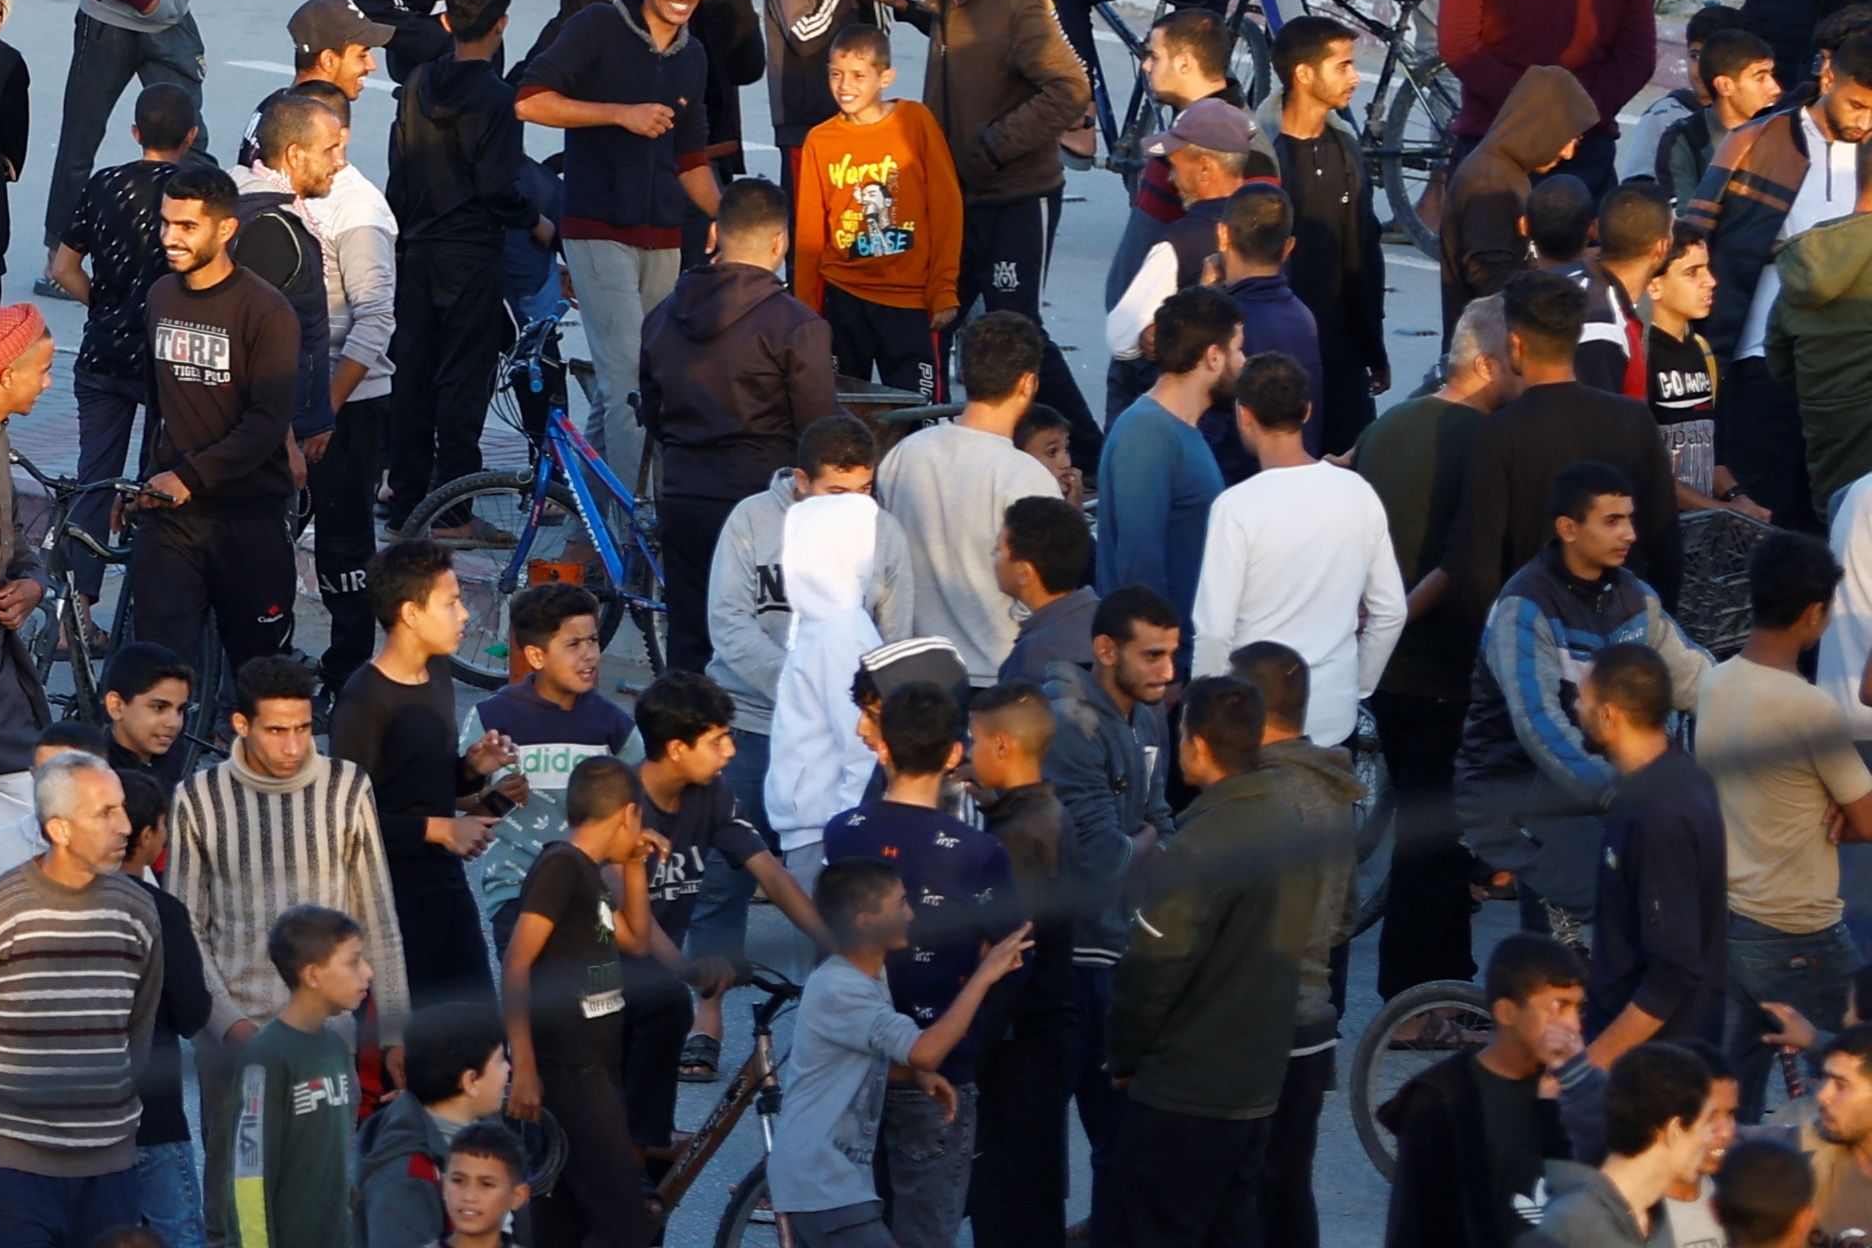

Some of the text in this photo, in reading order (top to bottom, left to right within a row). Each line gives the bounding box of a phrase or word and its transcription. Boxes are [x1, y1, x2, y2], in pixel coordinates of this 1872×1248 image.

[829, 153, 897, 189] Worst
[156, 328, 227, 367] TGRP
[1659, 370, 1684, 399] GO
